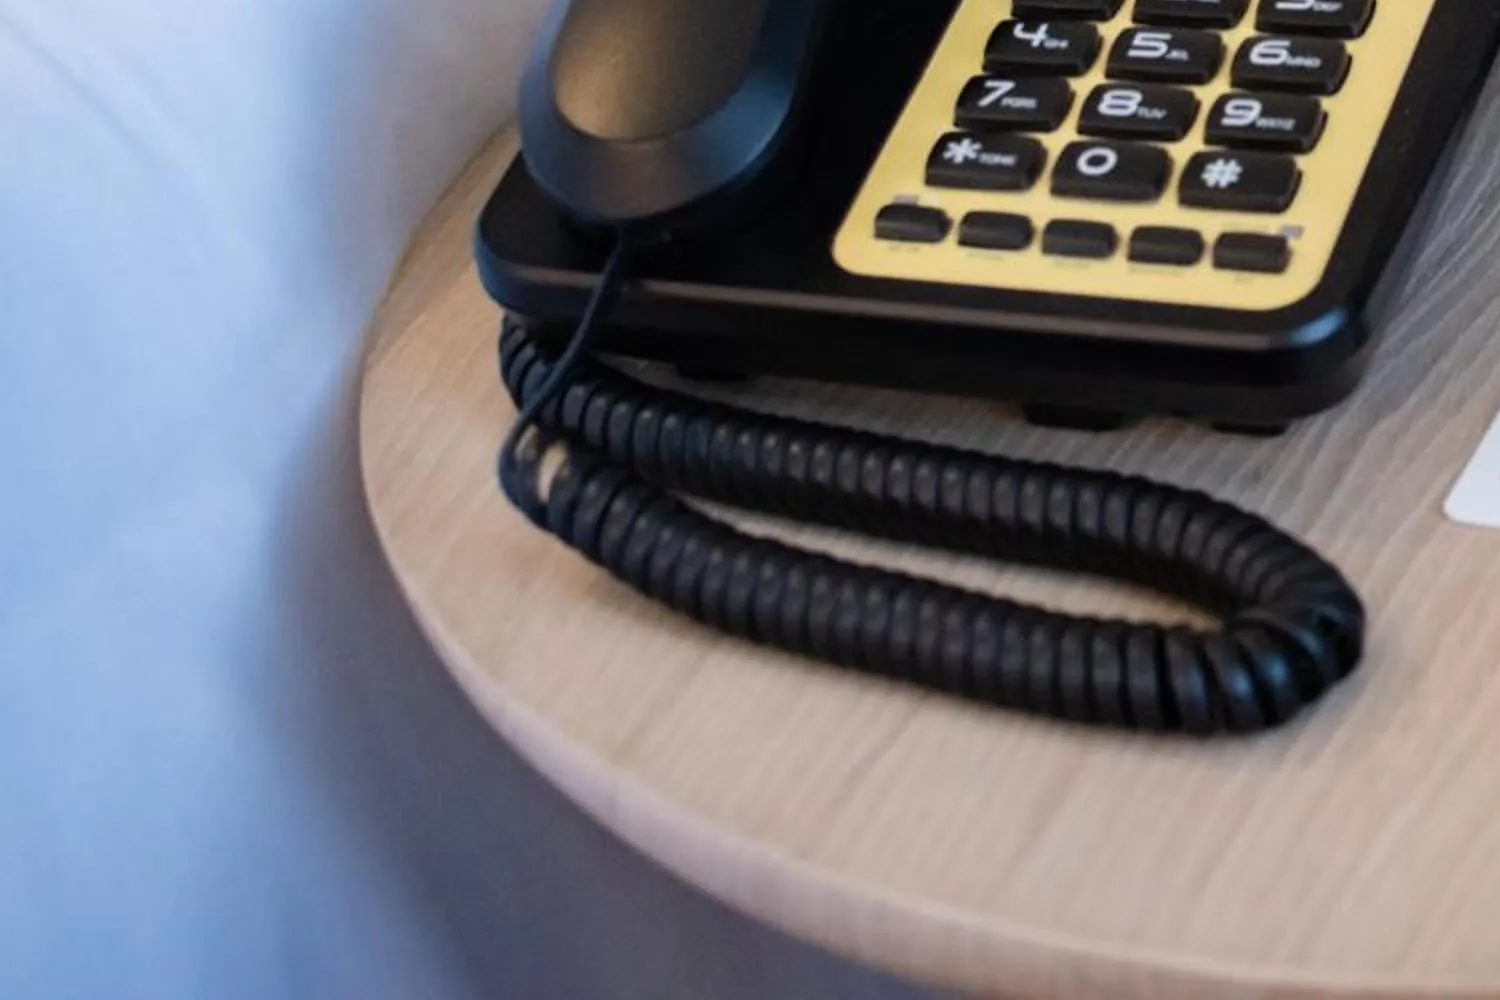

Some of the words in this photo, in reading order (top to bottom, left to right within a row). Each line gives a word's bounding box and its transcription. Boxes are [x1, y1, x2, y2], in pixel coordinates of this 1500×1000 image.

[1013, 22, 1048, 48] 4
[1127, 31, 1173, 58] 5
[1249, 40, 1291, 65] 6
[977, 80, 1016, 107] 7
[1098, 89, 1143, 116] 8
[1220, 98, 1263, 126] 9
[1201, 157, 1243, 188] #
